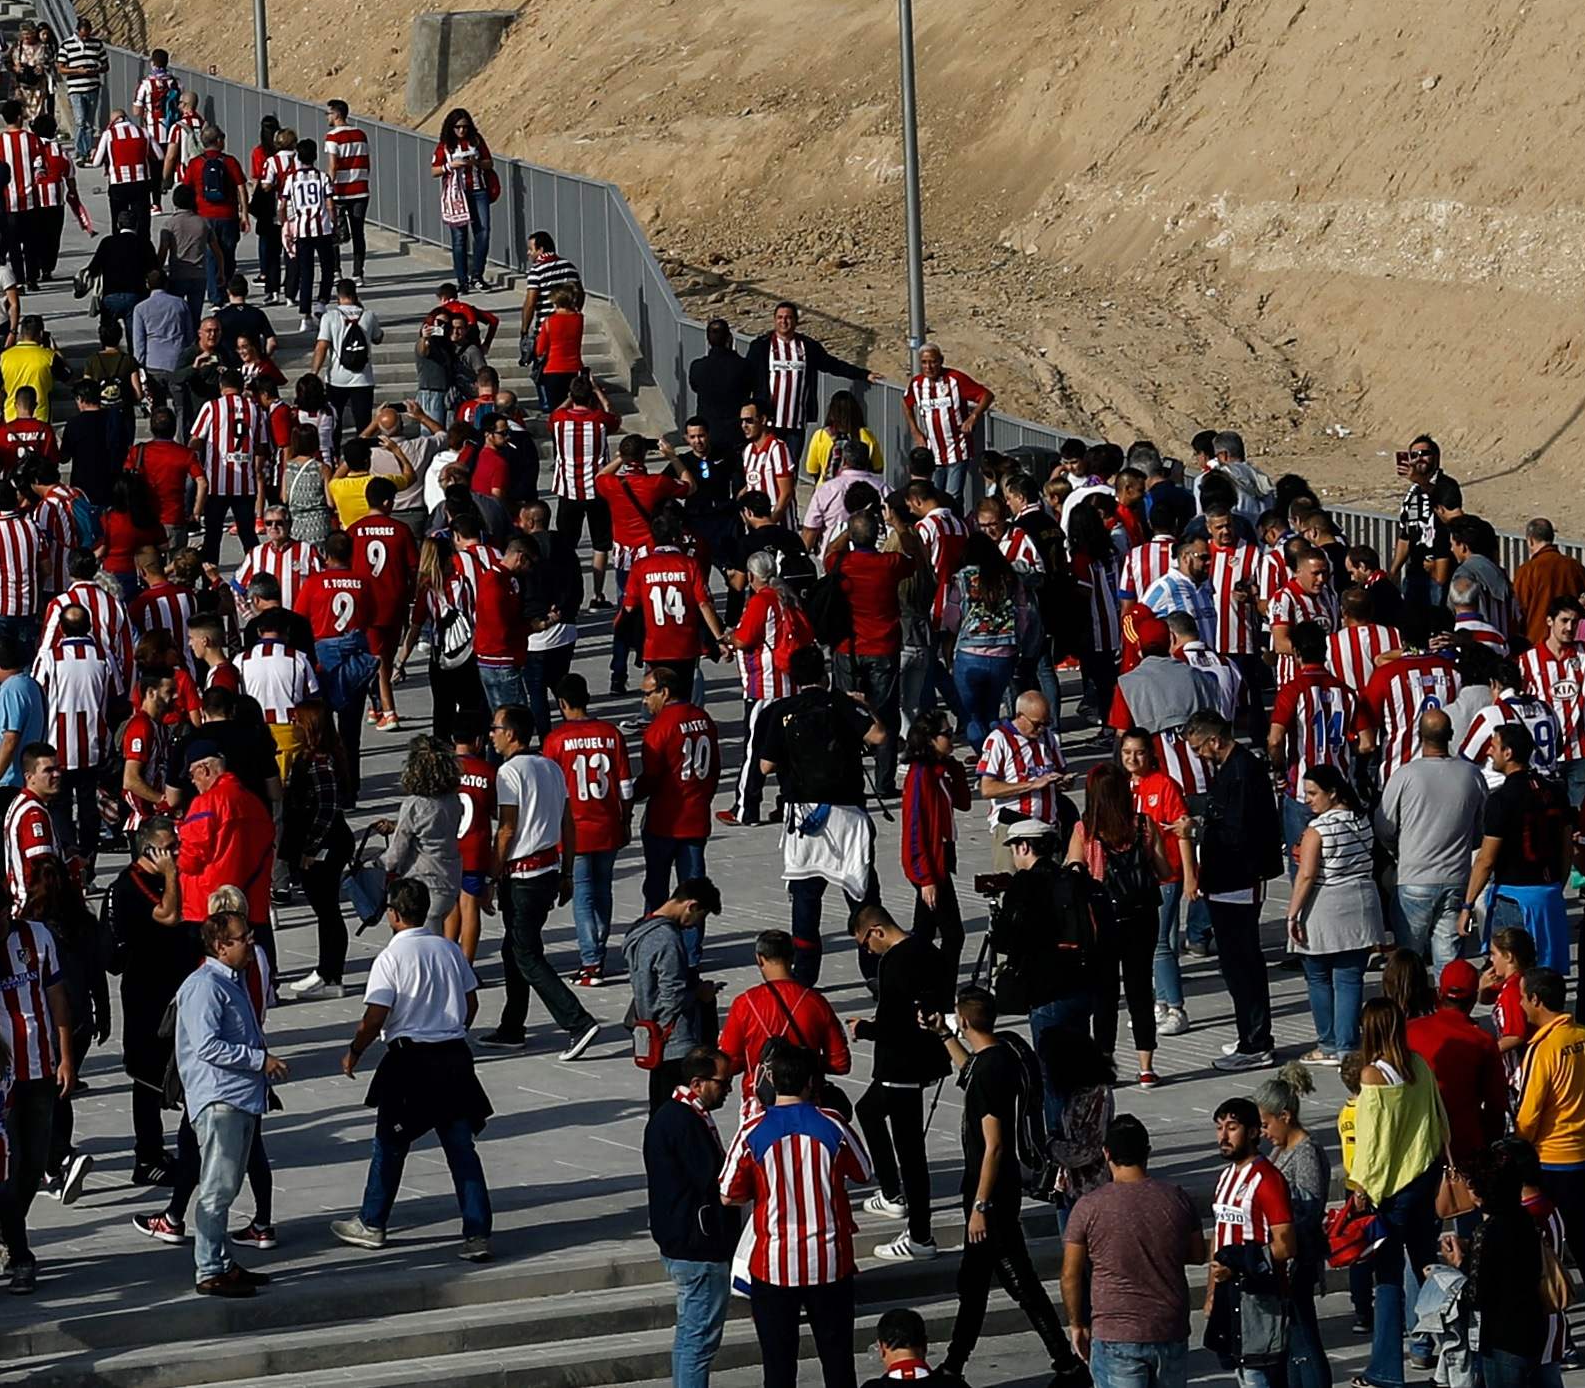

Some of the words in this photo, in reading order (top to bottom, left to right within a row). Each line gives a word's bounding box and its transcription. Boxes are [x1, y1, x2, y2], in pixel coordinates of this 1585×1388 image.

[297, 182, 318, 207] 19
[365, 527, 395, 537] TORRES
[367, 540, 387, 578] 9
[332, 578, 362, 589] TORRES
[645, 571, 687, 584] SIMEONE
[332, 591, 355, 632] 9
[649, 586, 686, 626] 14
[1554, 684, 1576, 695] KIA
[680, 721, 709, 734] MATEO
[1312, 709, 1345, 753] 14
[564, 737, 605, 752] MIGUEL
[607, 737, 614, 749] M
[1534, 720, 1555, 768] 9
[573, 753, 611, 802] 13
